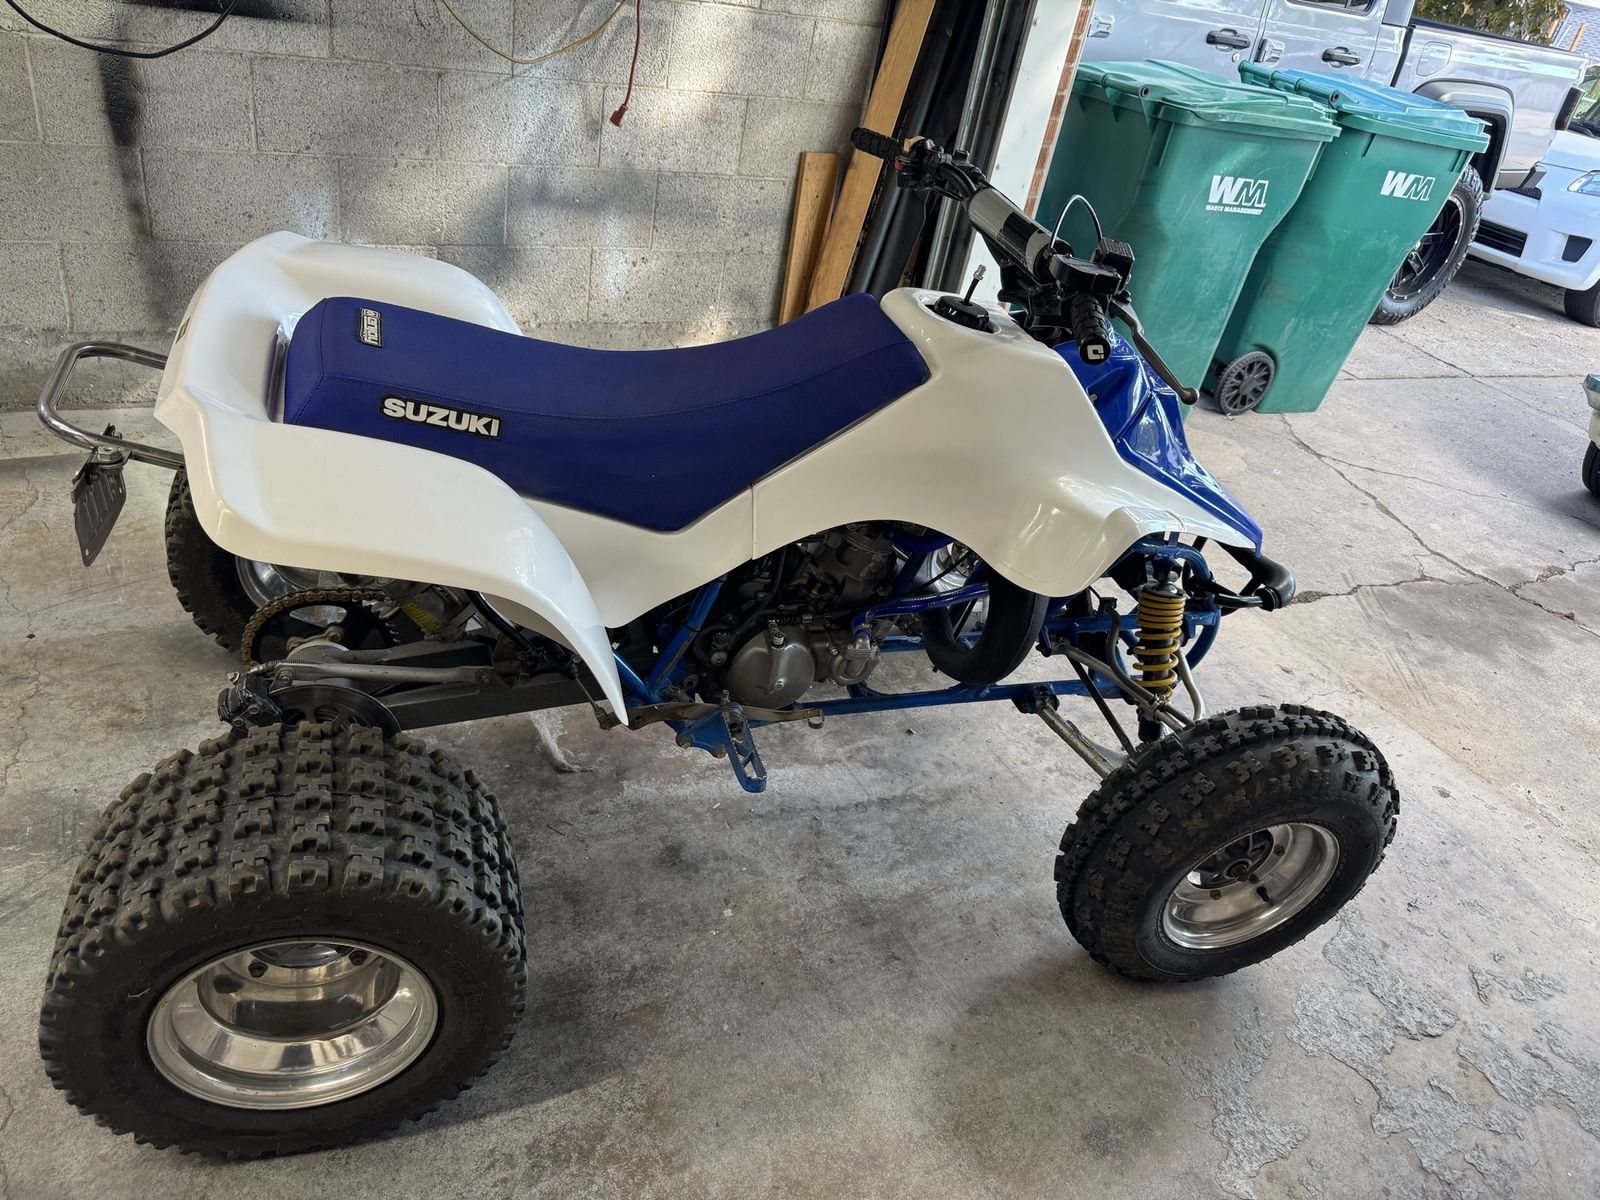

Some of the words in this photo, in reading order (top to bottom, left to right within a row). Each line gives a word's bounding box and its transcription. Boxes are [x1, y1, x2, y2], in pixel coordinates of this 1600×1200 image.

[1208, 174, 1269, 208] WM
[1380, 169, 1436, 202] WM
[1205, 204, 1224, 212] WASTE
[383, 397, 500, 437] SUZUKI
